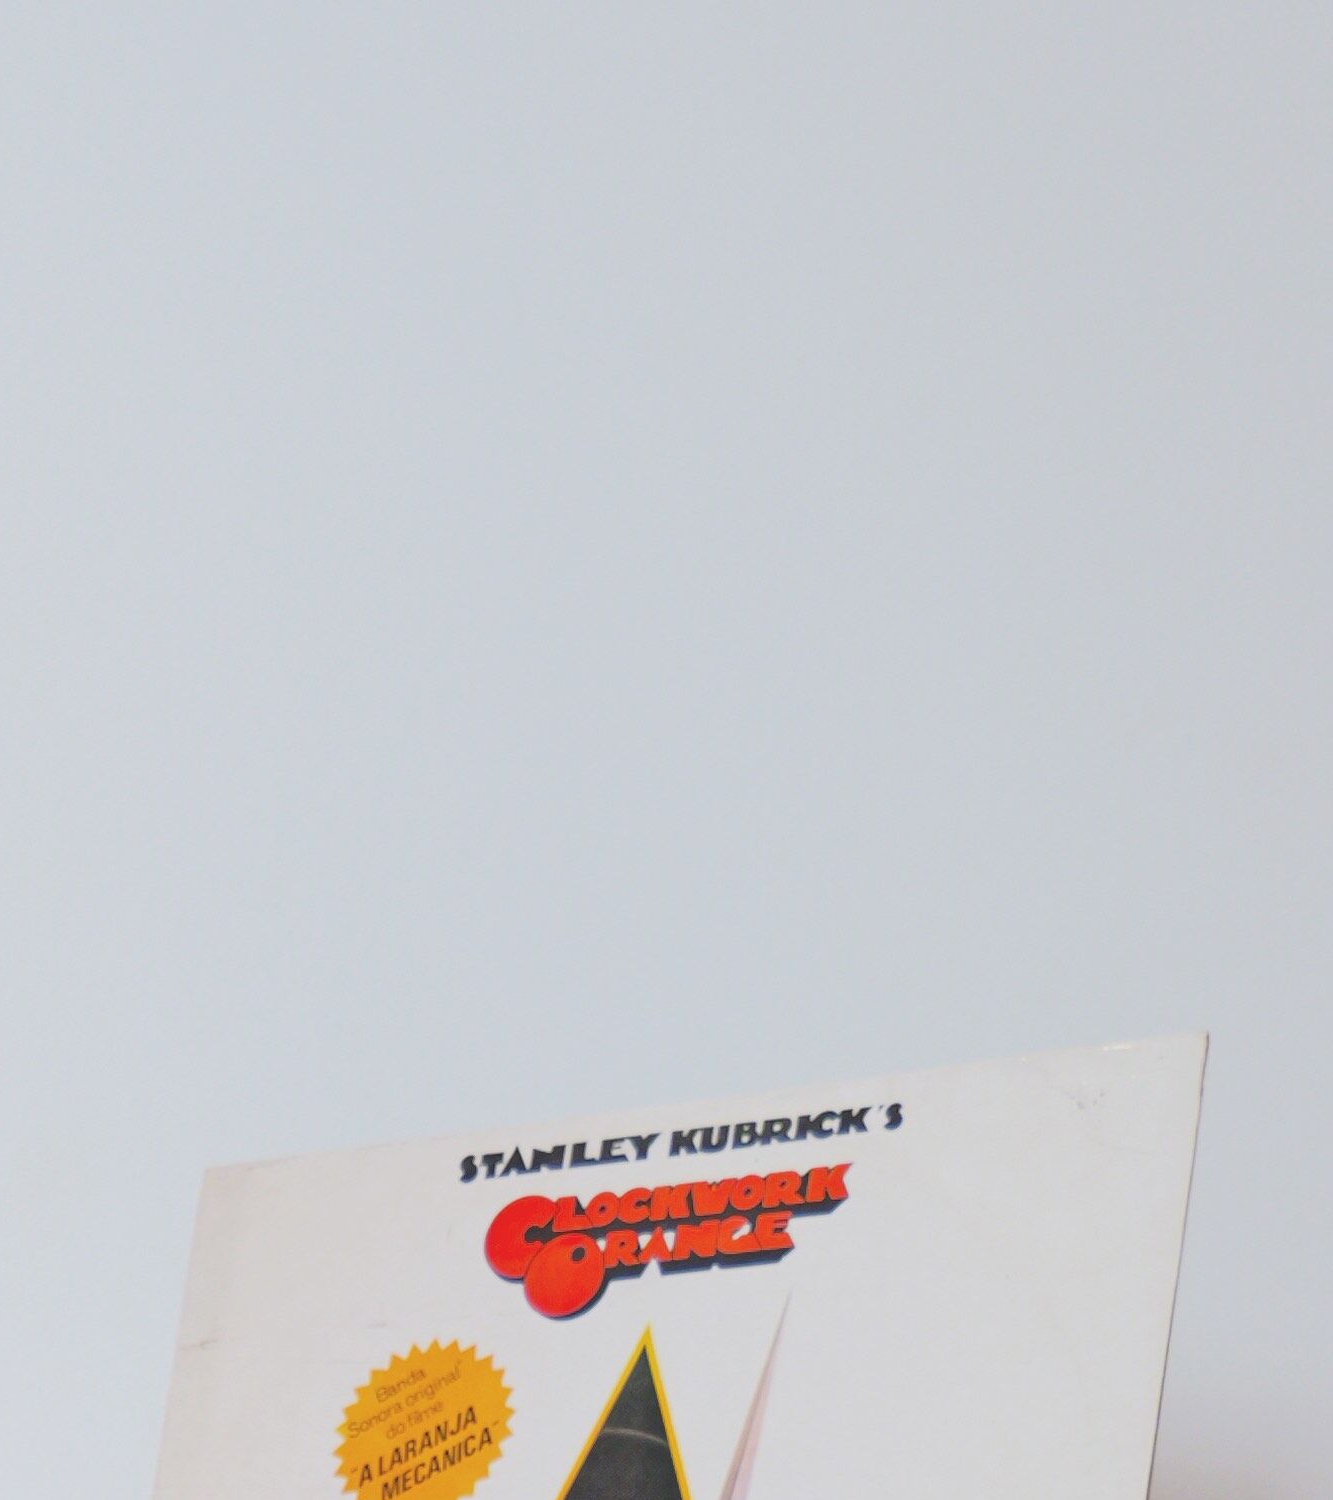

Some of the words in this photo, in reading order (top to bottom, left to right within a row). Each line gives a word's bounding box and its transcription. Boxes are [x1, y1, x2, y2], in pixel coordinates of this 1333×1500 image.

[460, 1132, 660, 1183] STANLEY
[669, 1102, 904, 1157] KUBRICK'S
[485, 1161, 854, 1283] CLOCKWORK
[524, 1211, 795, 1319] ORANGE
[347, 1402, 403, 1438] Sonora
[376, 1368, 427, 1402] Banda
[378, 1405, 478, 1476] LARANJA
